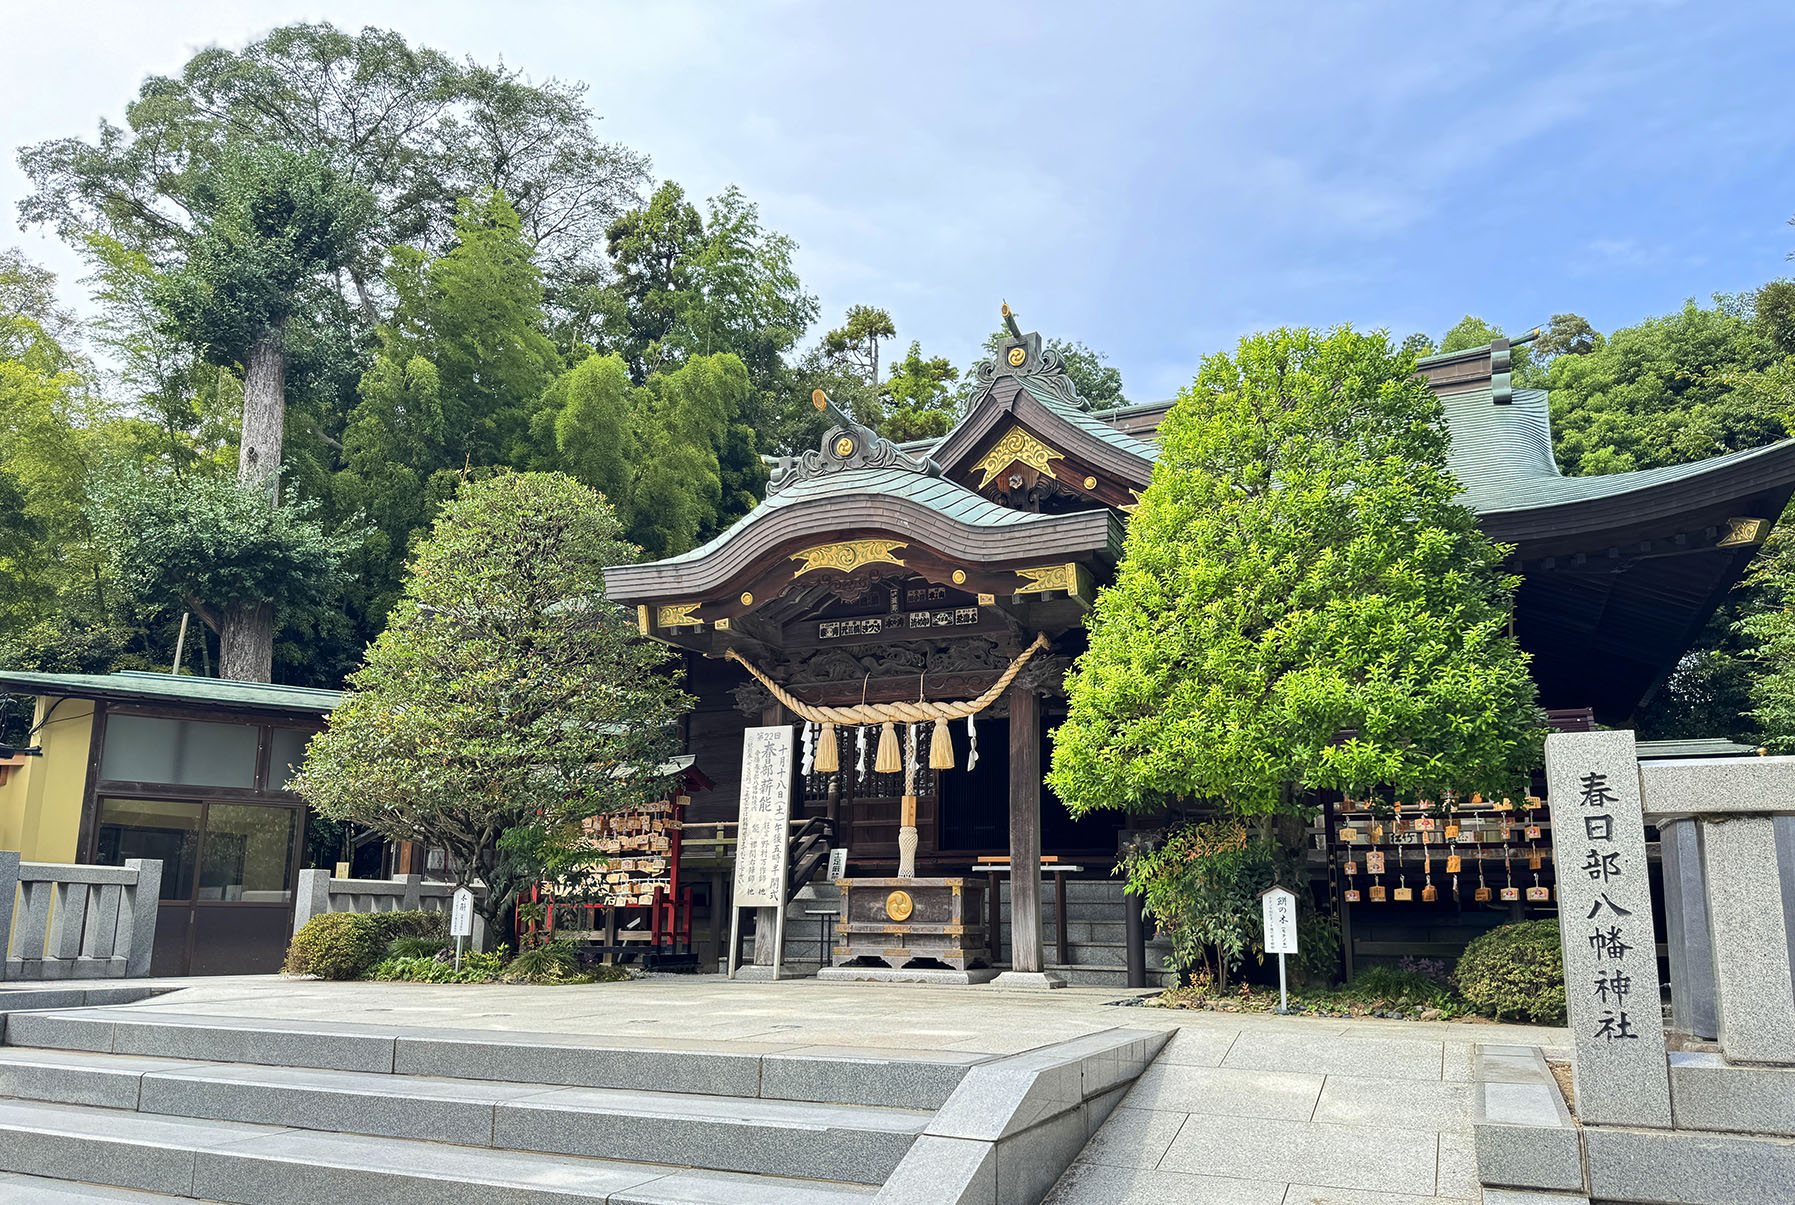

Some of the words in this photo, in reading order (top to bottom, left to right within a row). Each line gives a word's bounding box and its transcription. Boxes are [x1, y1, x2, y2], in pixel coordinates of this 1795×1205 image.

[758, 740, 777, 812] 春日部薪能
[1579, 771, 1639, 1041] 春日部八幡神社
